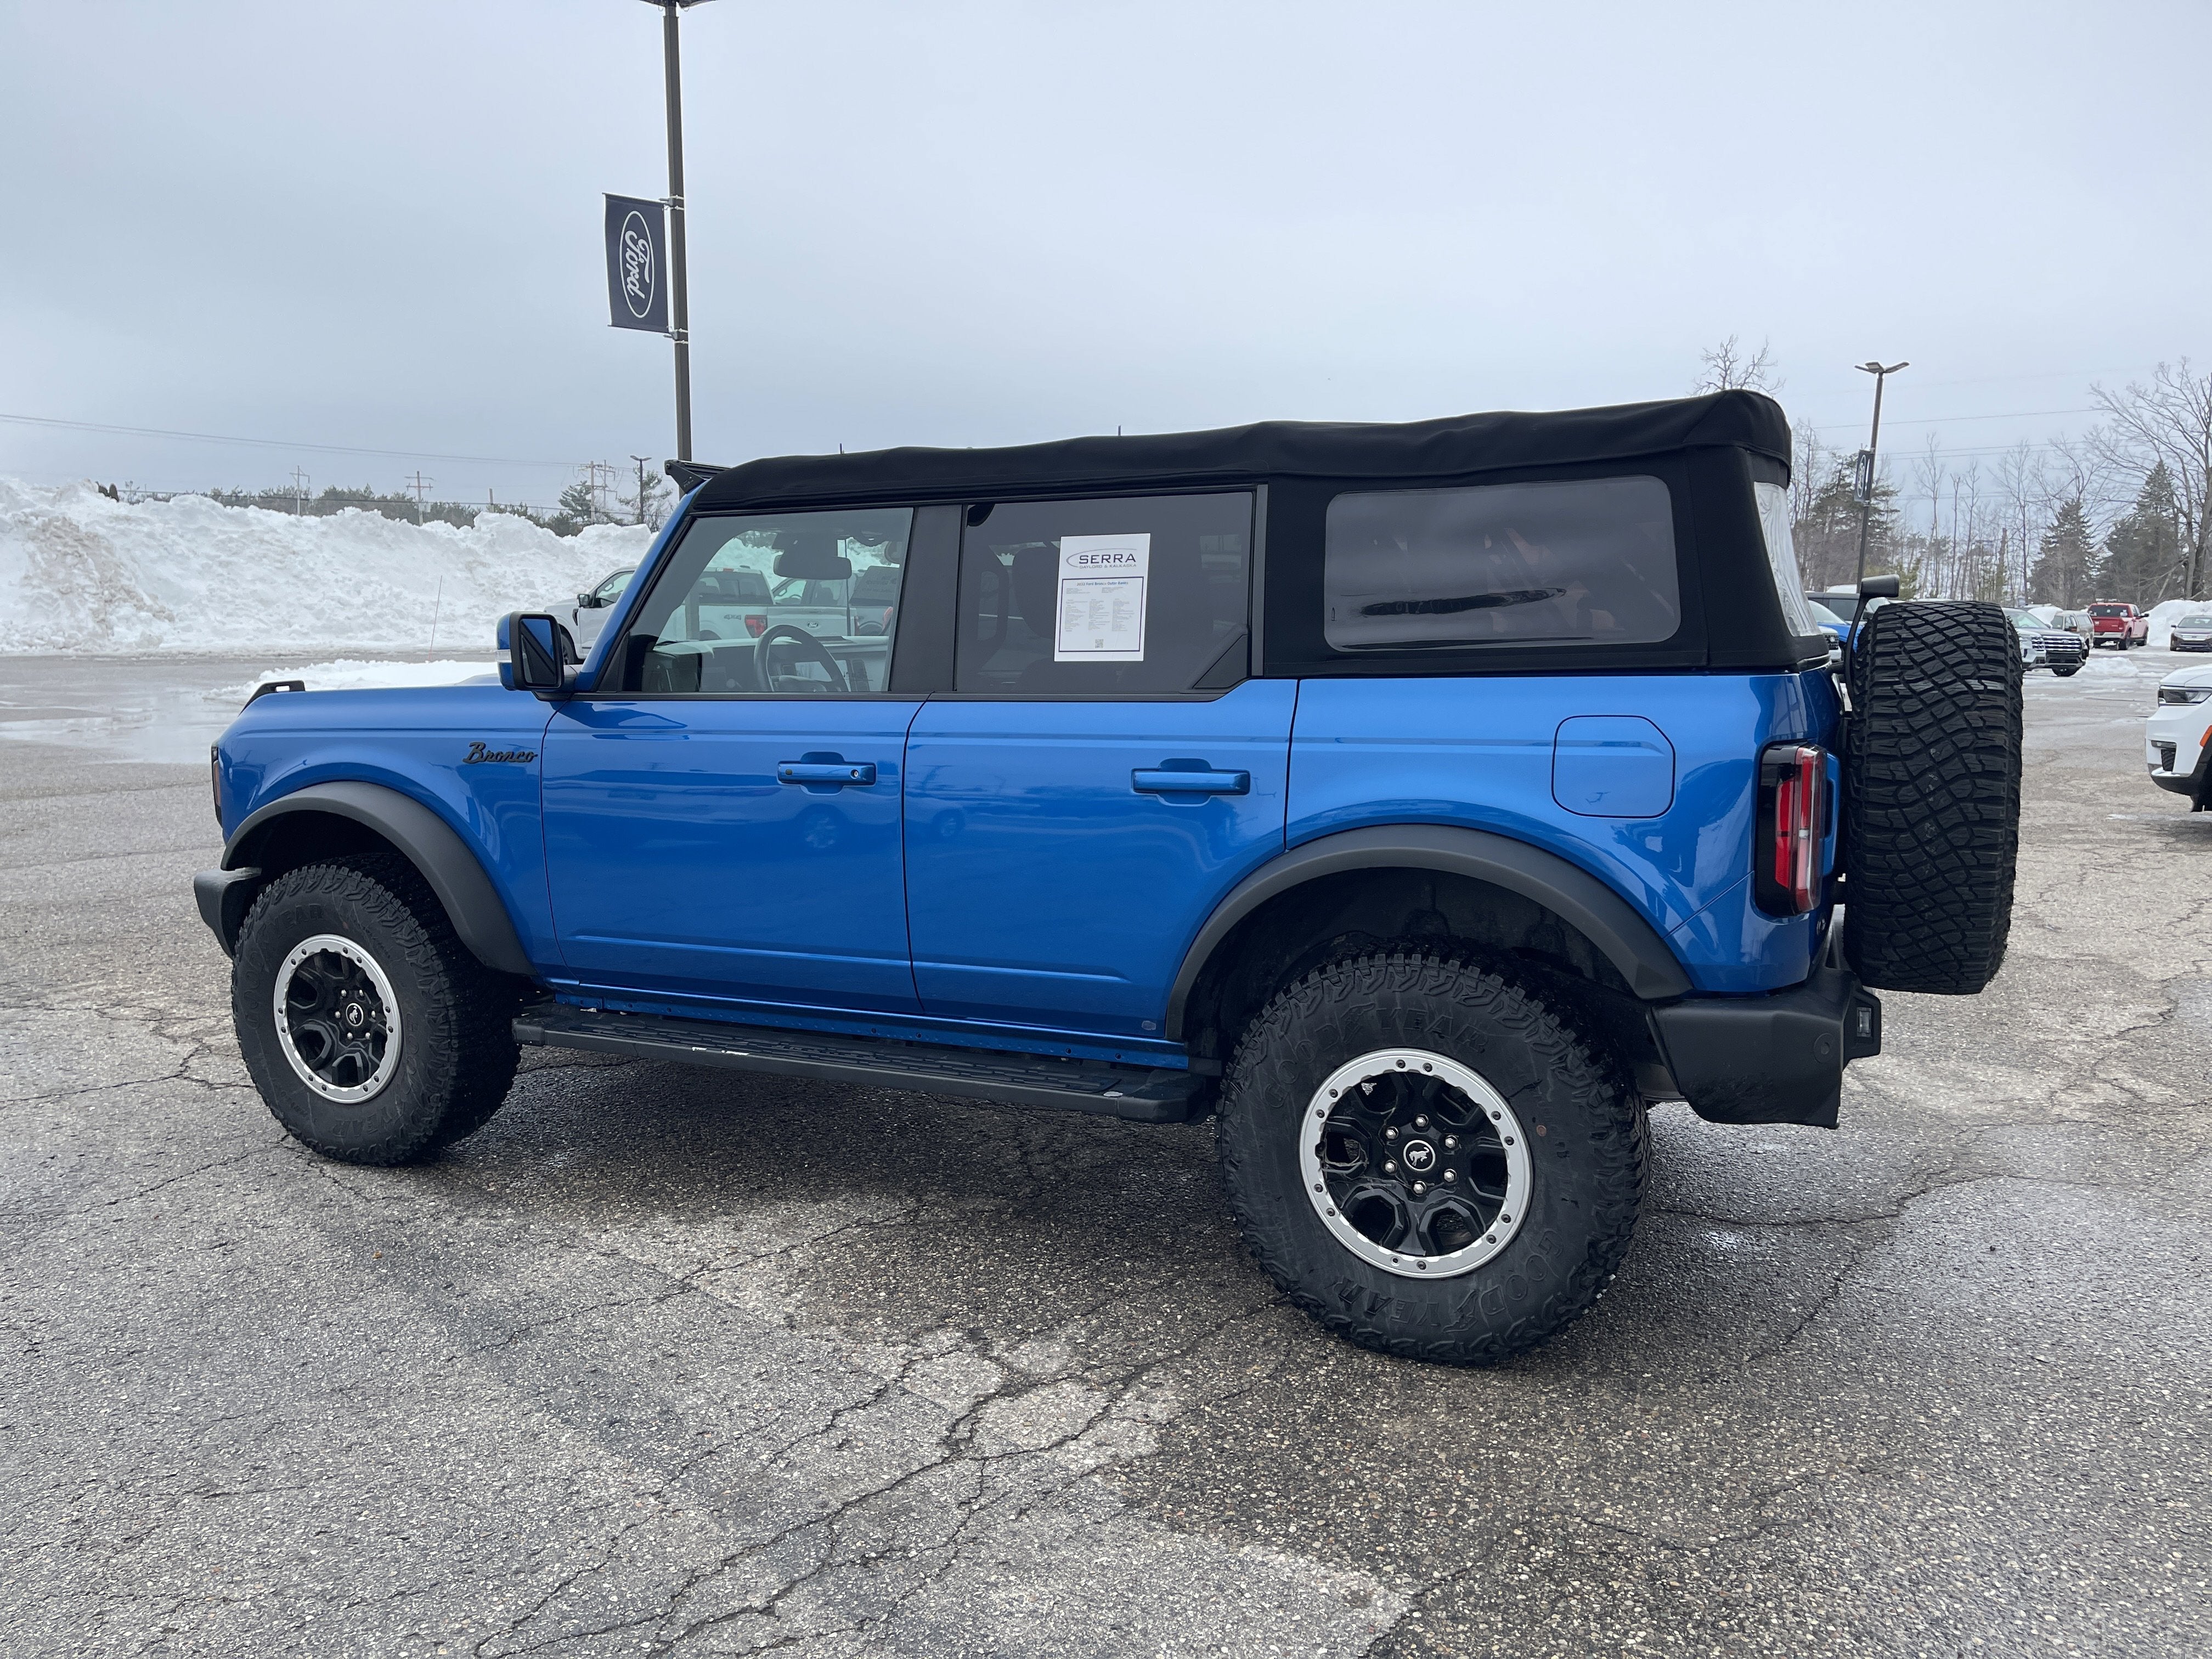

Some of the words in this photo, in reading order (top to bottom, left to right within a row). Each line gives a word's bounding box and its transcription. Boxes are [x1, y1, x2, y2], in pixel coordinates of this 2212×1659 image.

[625, 230, 650, 299] Ford
[1079, 553, 1136, 564] SERRA
[462, 741, 538, 764] Bronco
